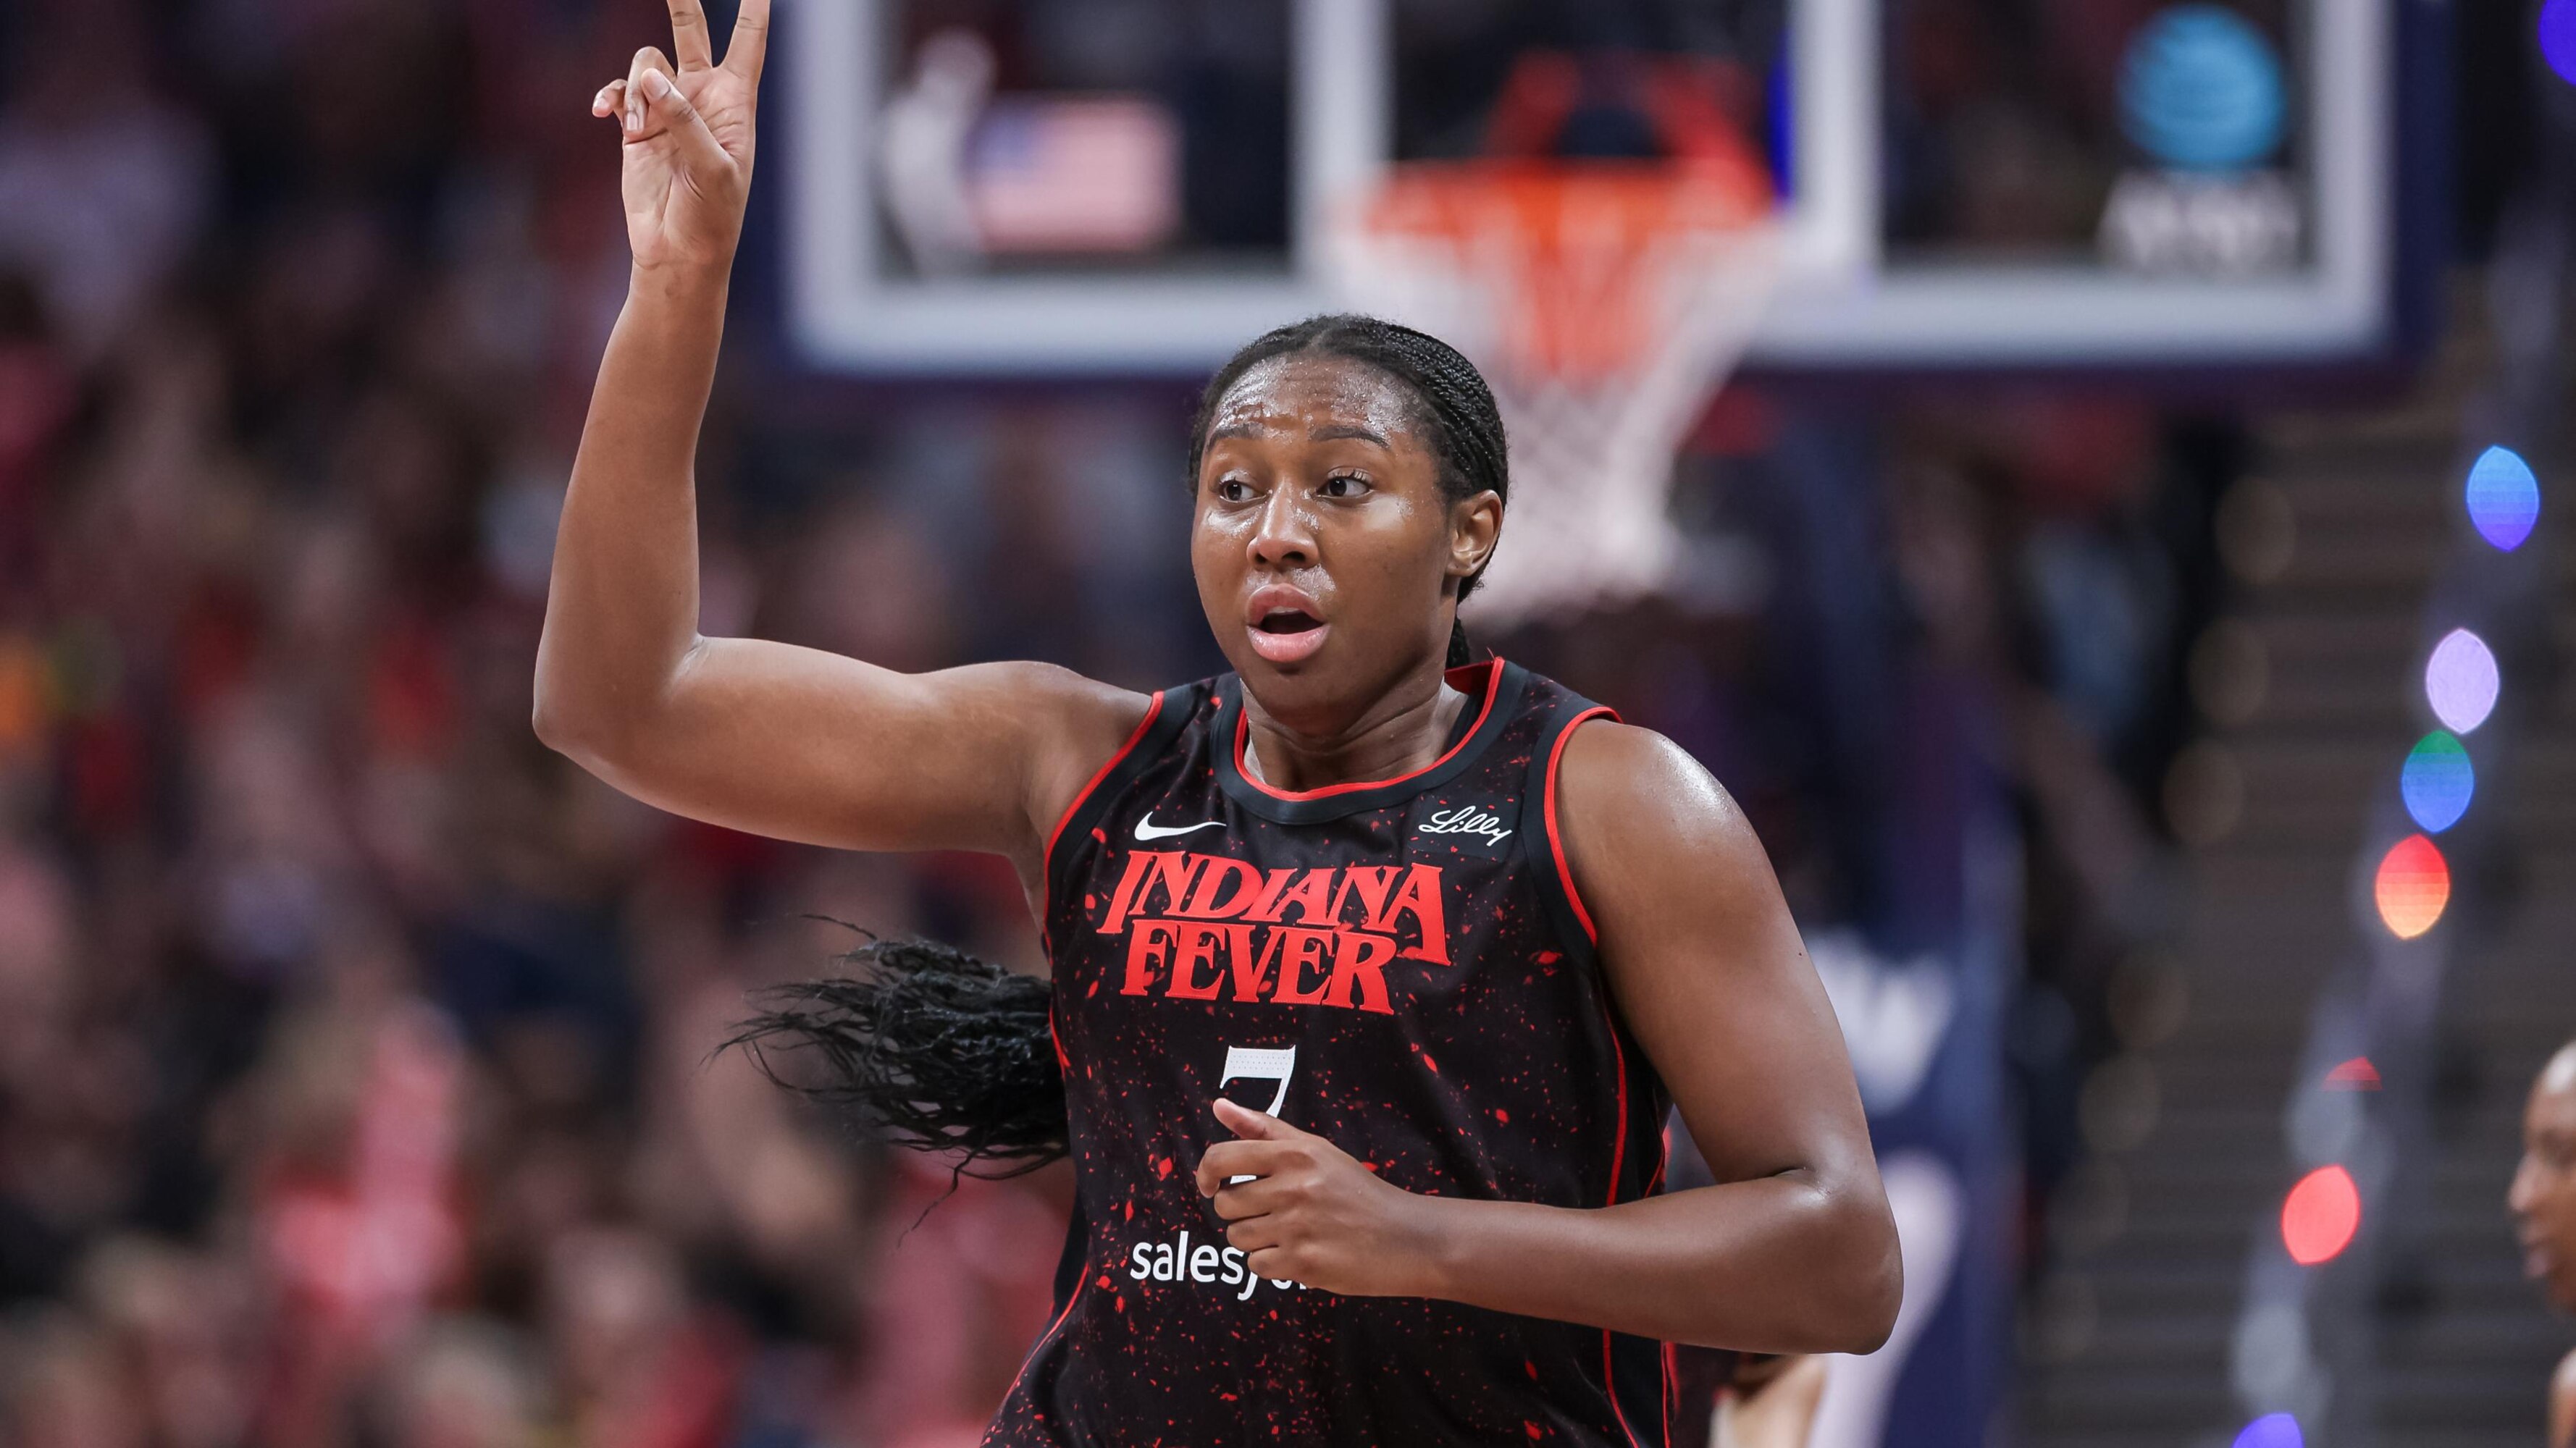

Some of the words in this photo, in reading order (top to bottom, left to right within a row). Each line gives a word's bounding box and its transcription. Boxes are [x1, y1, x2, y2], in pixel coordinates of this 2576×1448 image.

[1419, 805, 1513, 847] Lilly
[1096, 850, 1451, 966] INDIANA
[1120, 919, 1395, 1015] FEVER
[1219, 1045, 1296, 1184] 7
[1130, 1230, 1306, 1301] sales
